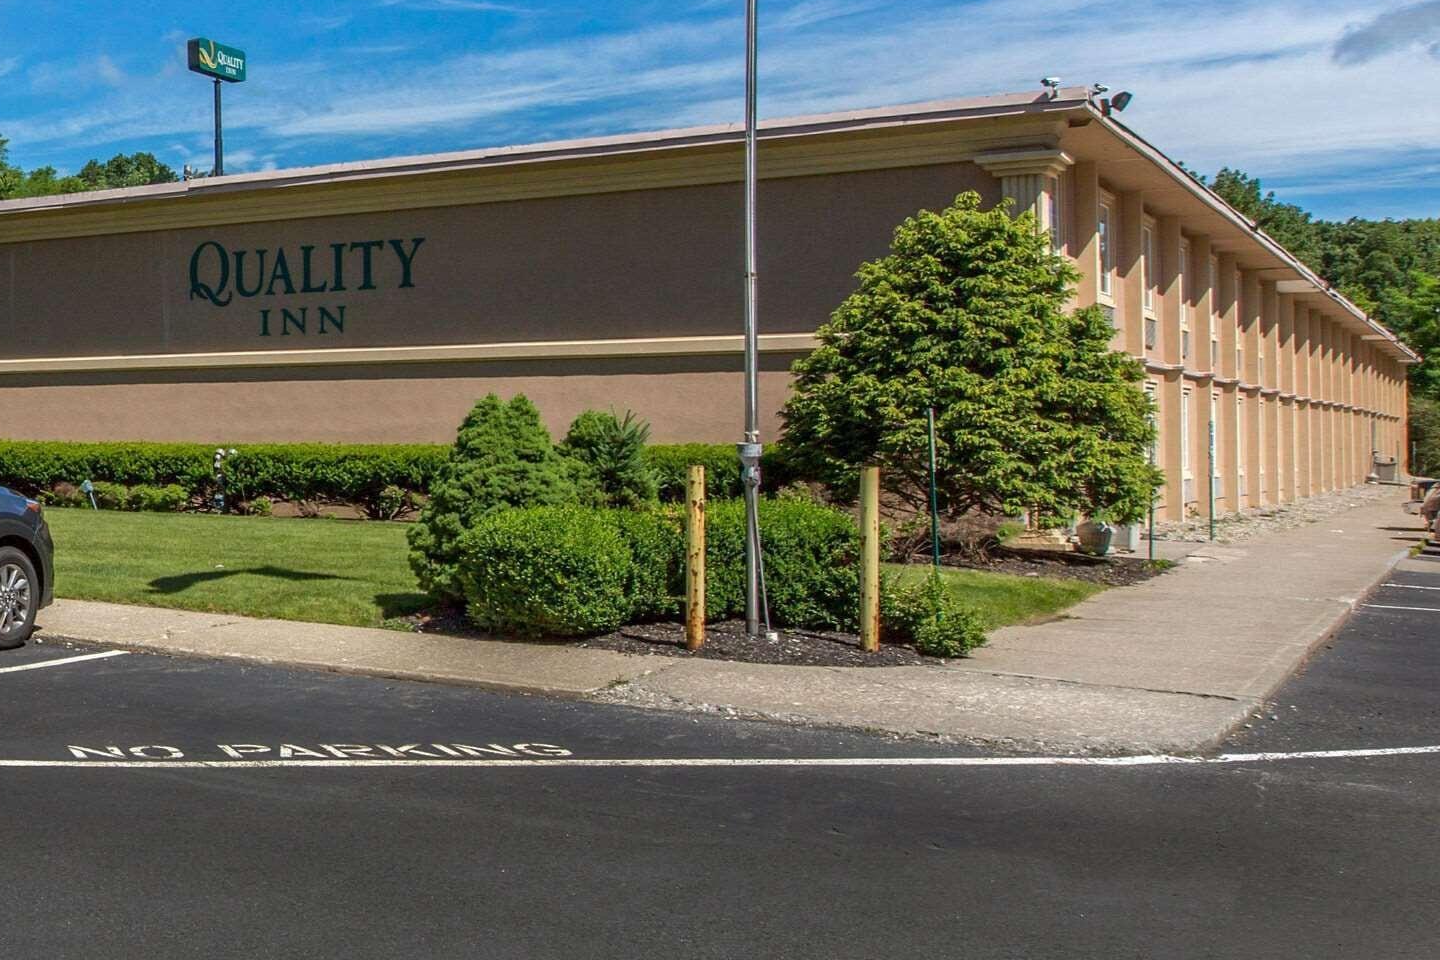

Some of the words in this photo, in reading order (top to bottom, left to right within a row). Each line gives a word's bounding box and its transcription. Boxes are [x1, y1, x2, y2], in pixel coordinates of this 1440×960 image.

[217, 50, 244, 70] QUALITY
[189, 237, 426, 307] QUALITY
[259, 305, 346, 336] INN
[67, 745, 184, 759] NO
[217, 743, 573, 759] PARKING
